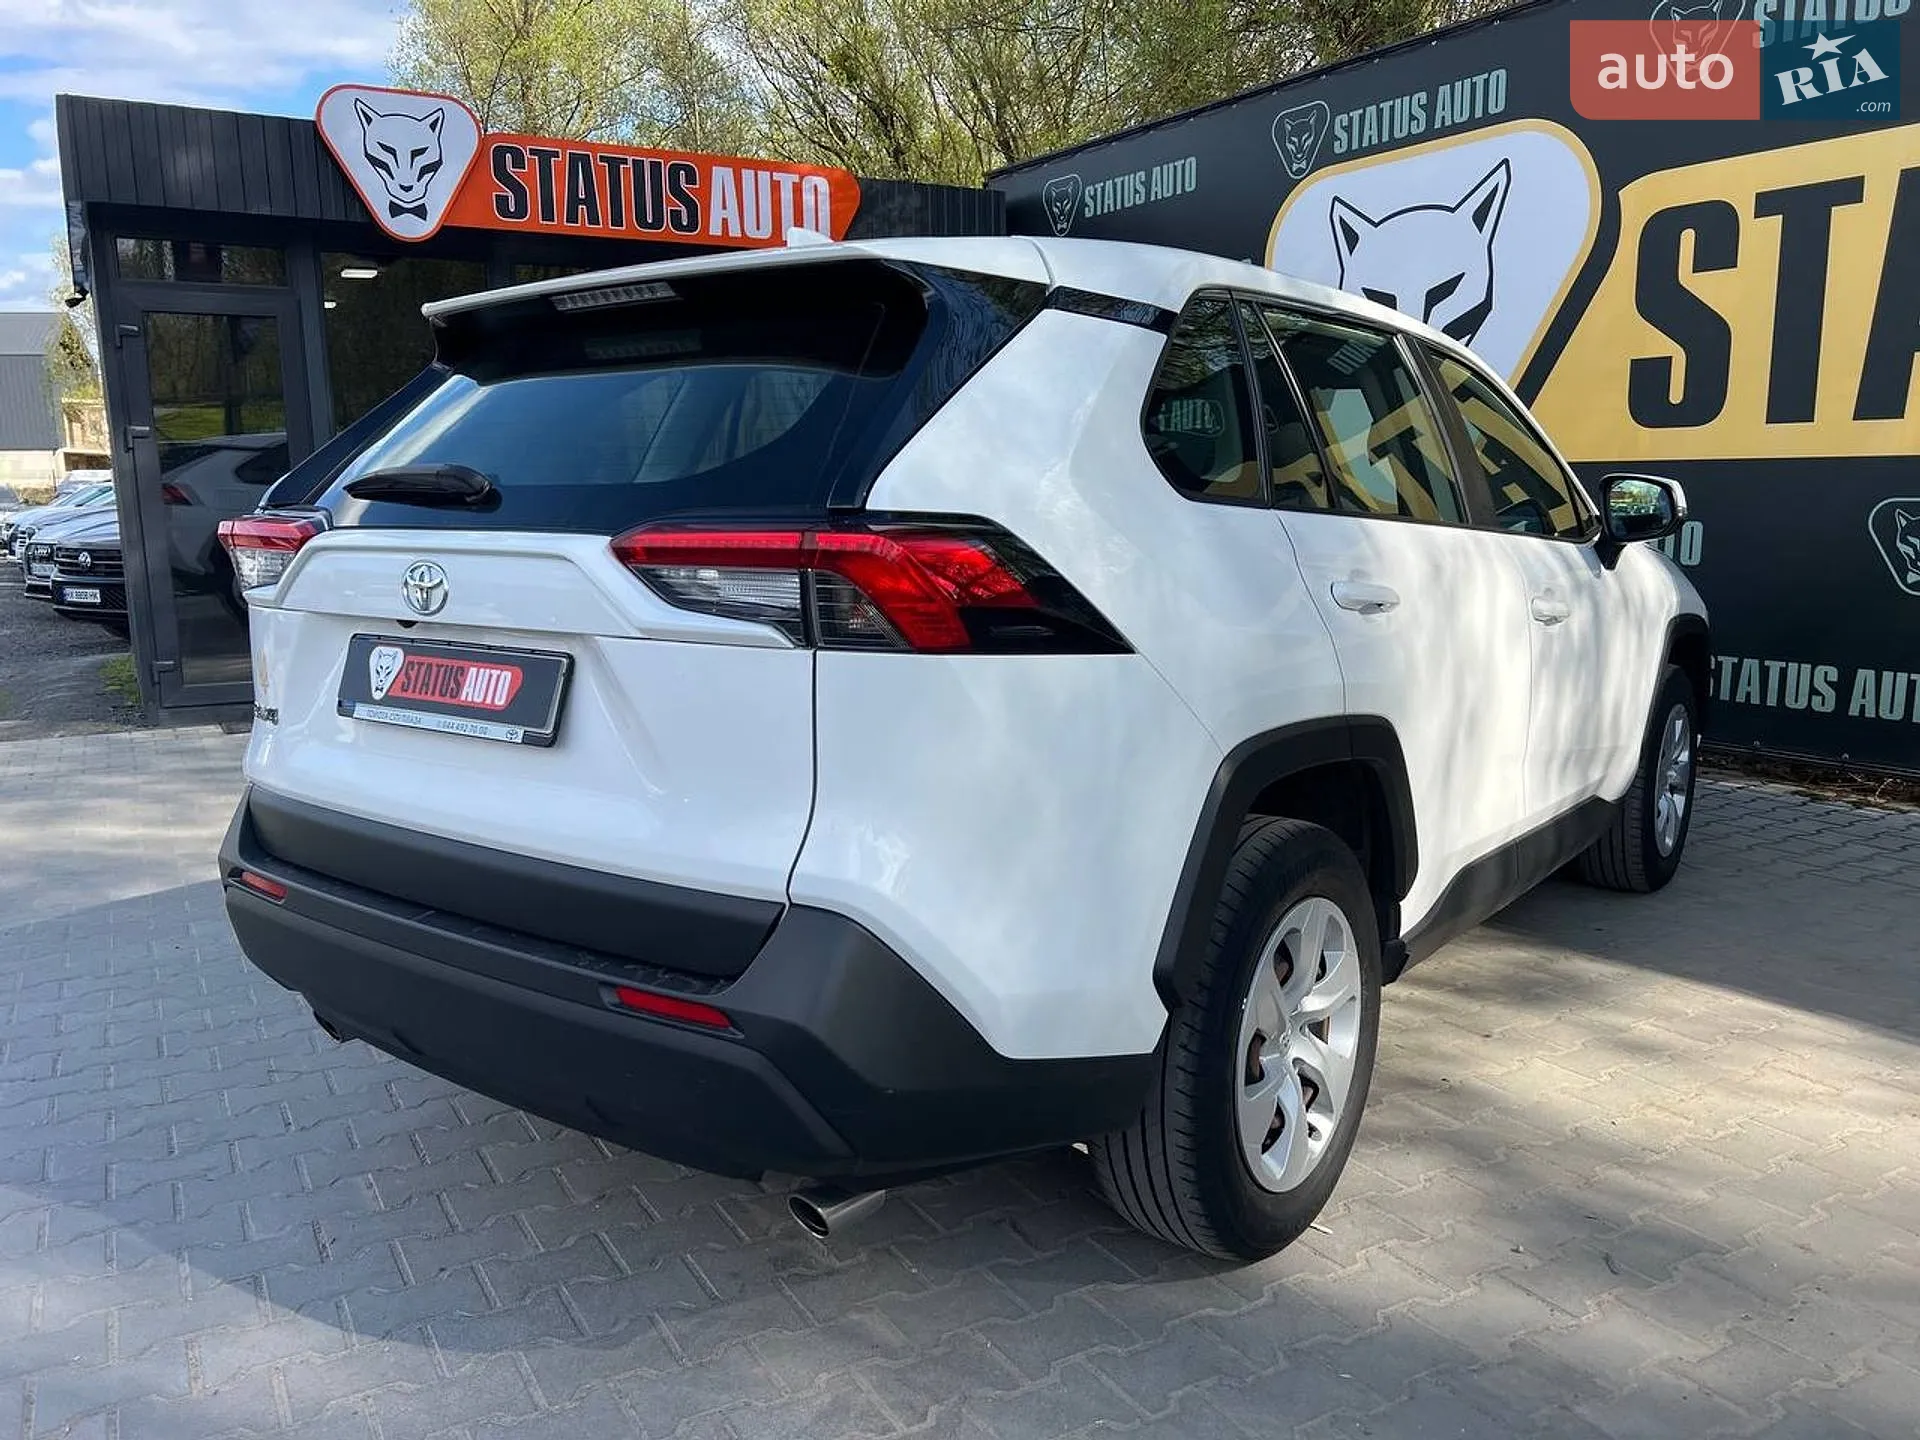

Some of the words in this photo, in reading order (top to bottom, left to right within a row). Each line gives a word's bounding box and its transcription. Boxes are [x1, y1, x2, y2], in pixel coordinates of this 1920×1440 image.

[1752, 0, 1911, 48] STA
[1333, 90, 1427, 154] STATUS
[1435, 69, 1508, 126] AUTO
[490, 143, 701, 235] STATUS
[708, 166, 832, 242] AUTO
[1083, 168, 1146, 219] STATUS
[1150, 156, 1198, 204] AUTO
[401, 659, 465, 700] STATUS
[461, 667, 513, 705] AUTO
[1709, 655, 1839, 714] TATUS
